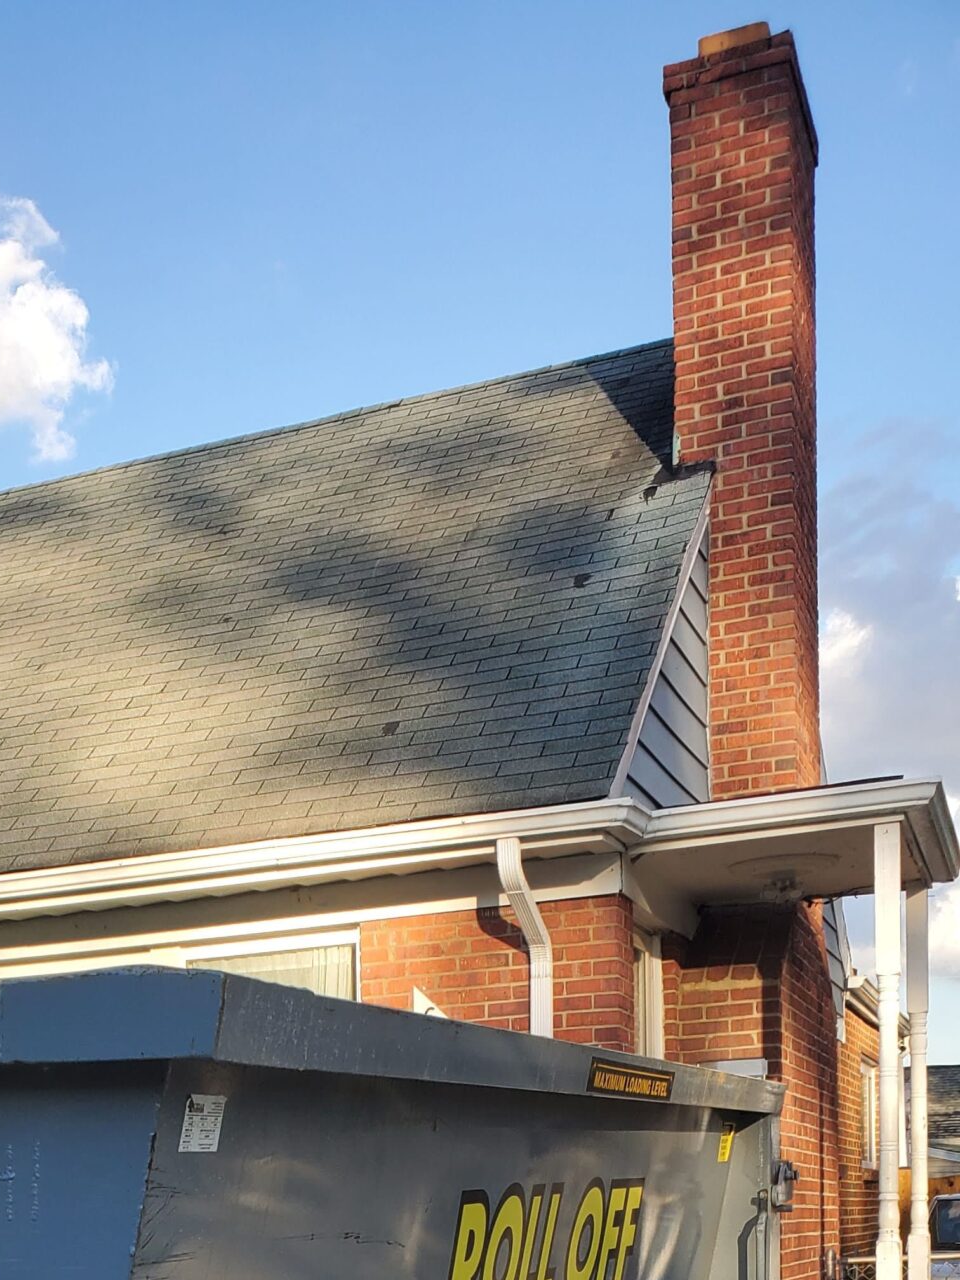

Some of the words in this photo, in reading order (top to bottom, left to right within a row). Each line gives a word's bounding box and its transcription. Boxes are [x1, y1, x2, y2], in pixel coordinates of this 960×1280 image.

[593, 1071, 625, 1092] MAXIMUM
[625, 1075, 651, 1096] LOADING
[650, 1080, 668, 1097] LEVEL
